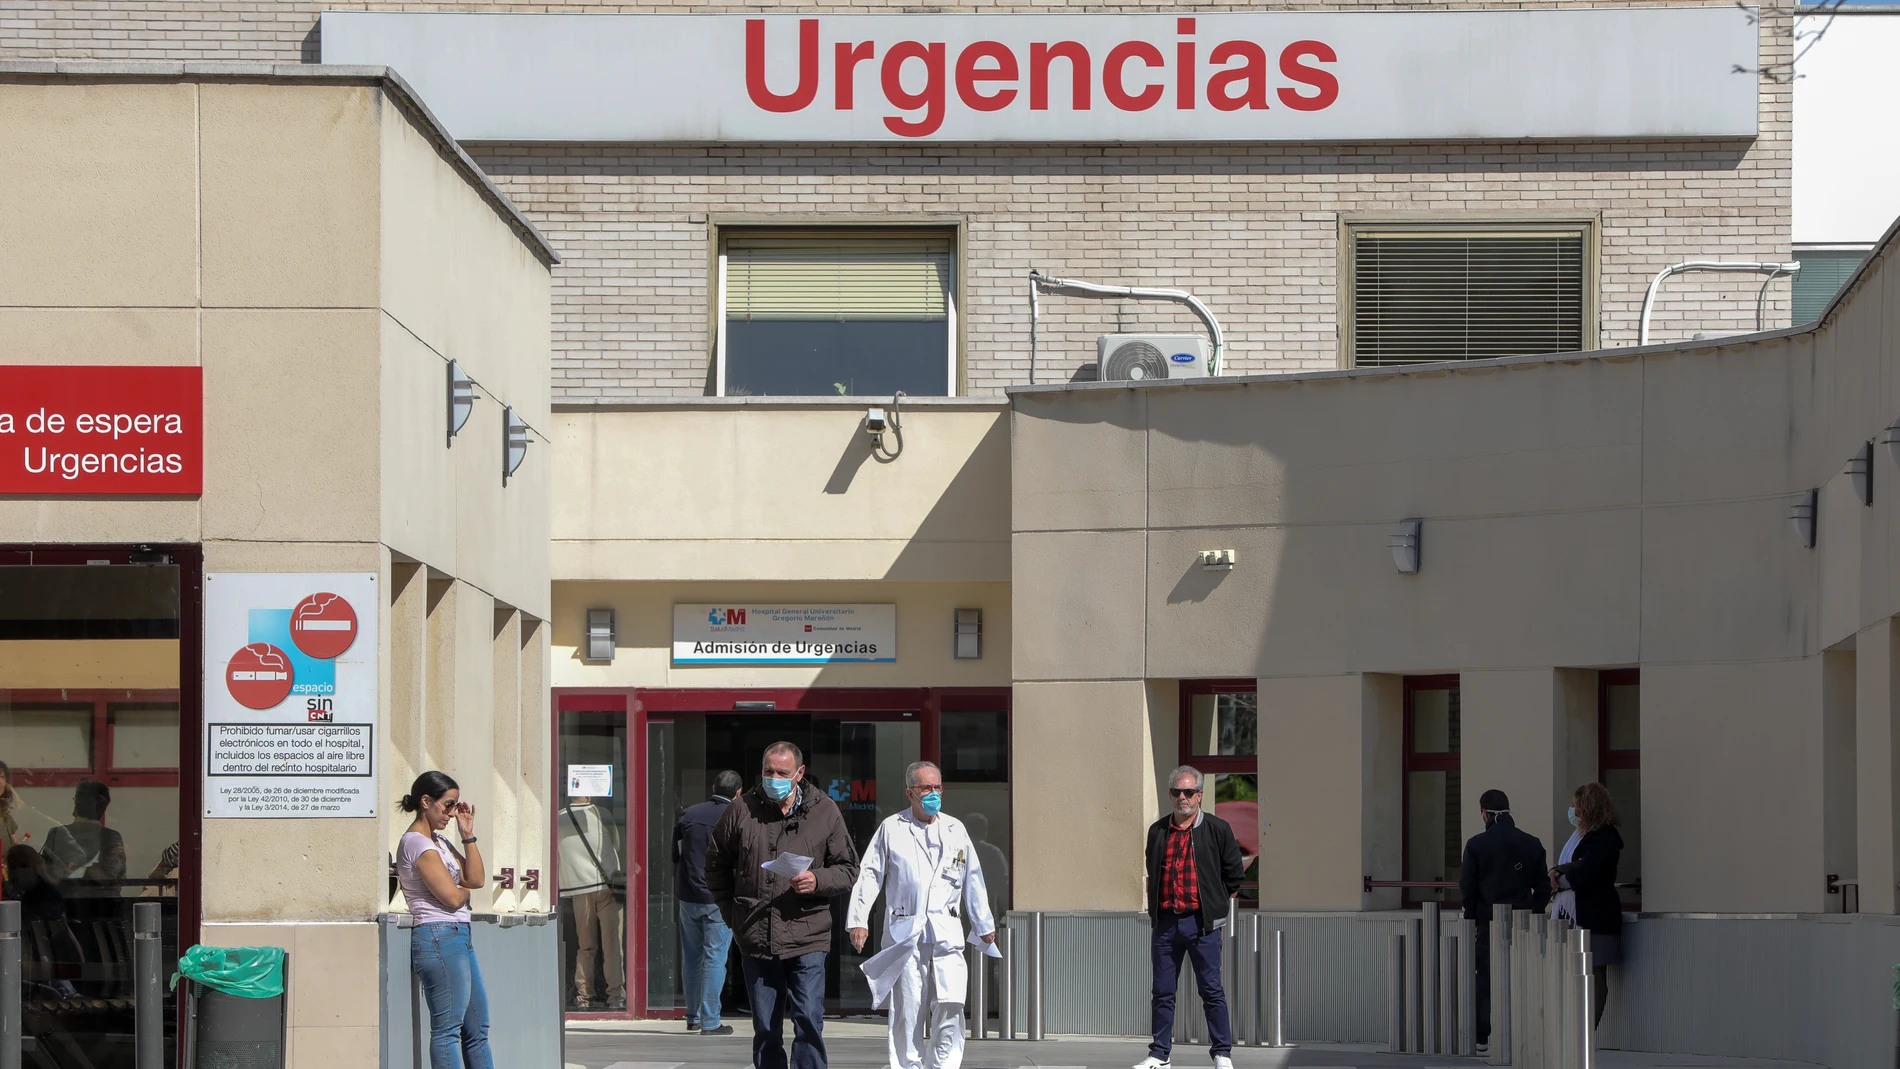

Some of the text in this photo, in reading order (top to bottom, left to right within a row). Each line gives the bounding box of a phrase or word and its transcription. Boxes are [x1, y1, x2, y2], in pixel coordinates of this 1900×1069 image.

[744, 18, 1341, 138] Urgencias
[26, 407, 65, 433] de
[76, 413, 182, 440] espera
[24, 447, 182, 480] Urgencias
[693, 641, 877, 656] Admisión de Urgencias
[292, 682, 333, 694] espacio
[307, 694, 332, 710] sin
[220, 726, 360, 738] Prohibido fumar/usar cigarrillos
[219, 739, 274, 748] electrónicos
[291, 739, 312, 748] todo
[315, 739, 322, 748] el
[215, 751, 365, 762] incluidos los espacios al aire libre
[223, 763, 252, 772] dentro
[255, 763, 269, 772] del
[305, 763, 357, 774] hospitalario
